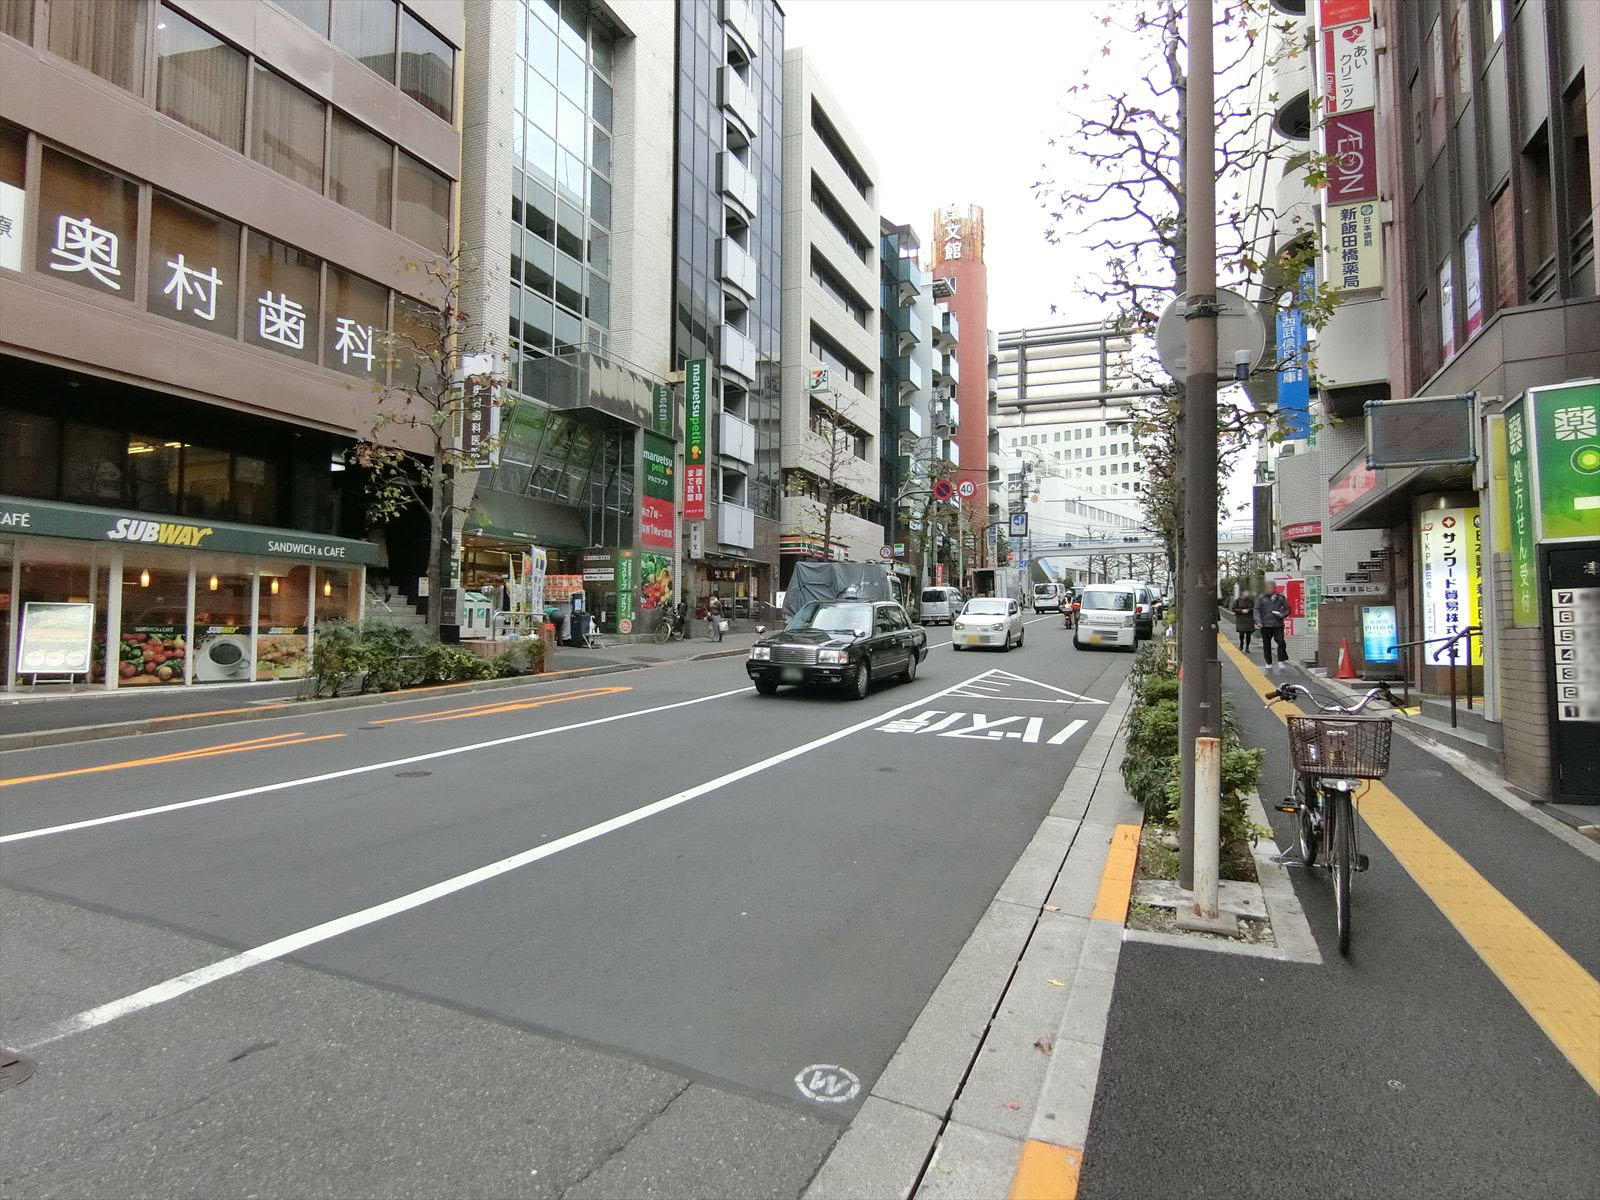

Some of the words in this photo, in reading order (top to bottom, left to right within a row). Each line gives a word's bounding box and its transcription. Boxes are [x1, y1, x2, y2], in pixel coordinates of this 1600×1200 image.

[1353, 45, 1368, 70] あい
[1340, 54, 1354, 110] クリニック
[944, 205, 962, 260] 文館
[1363, 217, 1373, 247] 日本調剤
[1340, 207, 1360, 289] 新飯田橋薬局
[51, 215, 376, 372] 奥村歯科
[1554, 405, 1597, 441] 薬
[643, 450, 673, 467] maruetsu
[960, 484, 973, 494] 40
[0, 512, 31, 527] AFÉ
[107, 518, 214, 547] SUBWAY
[268, 541, 316, 555] SANDWICH
[1513, 460, 1530, 613] 処方せん受付
[268, 626, 298, 634] SUBWAY
[875, 710, 1089, 745] バス停
